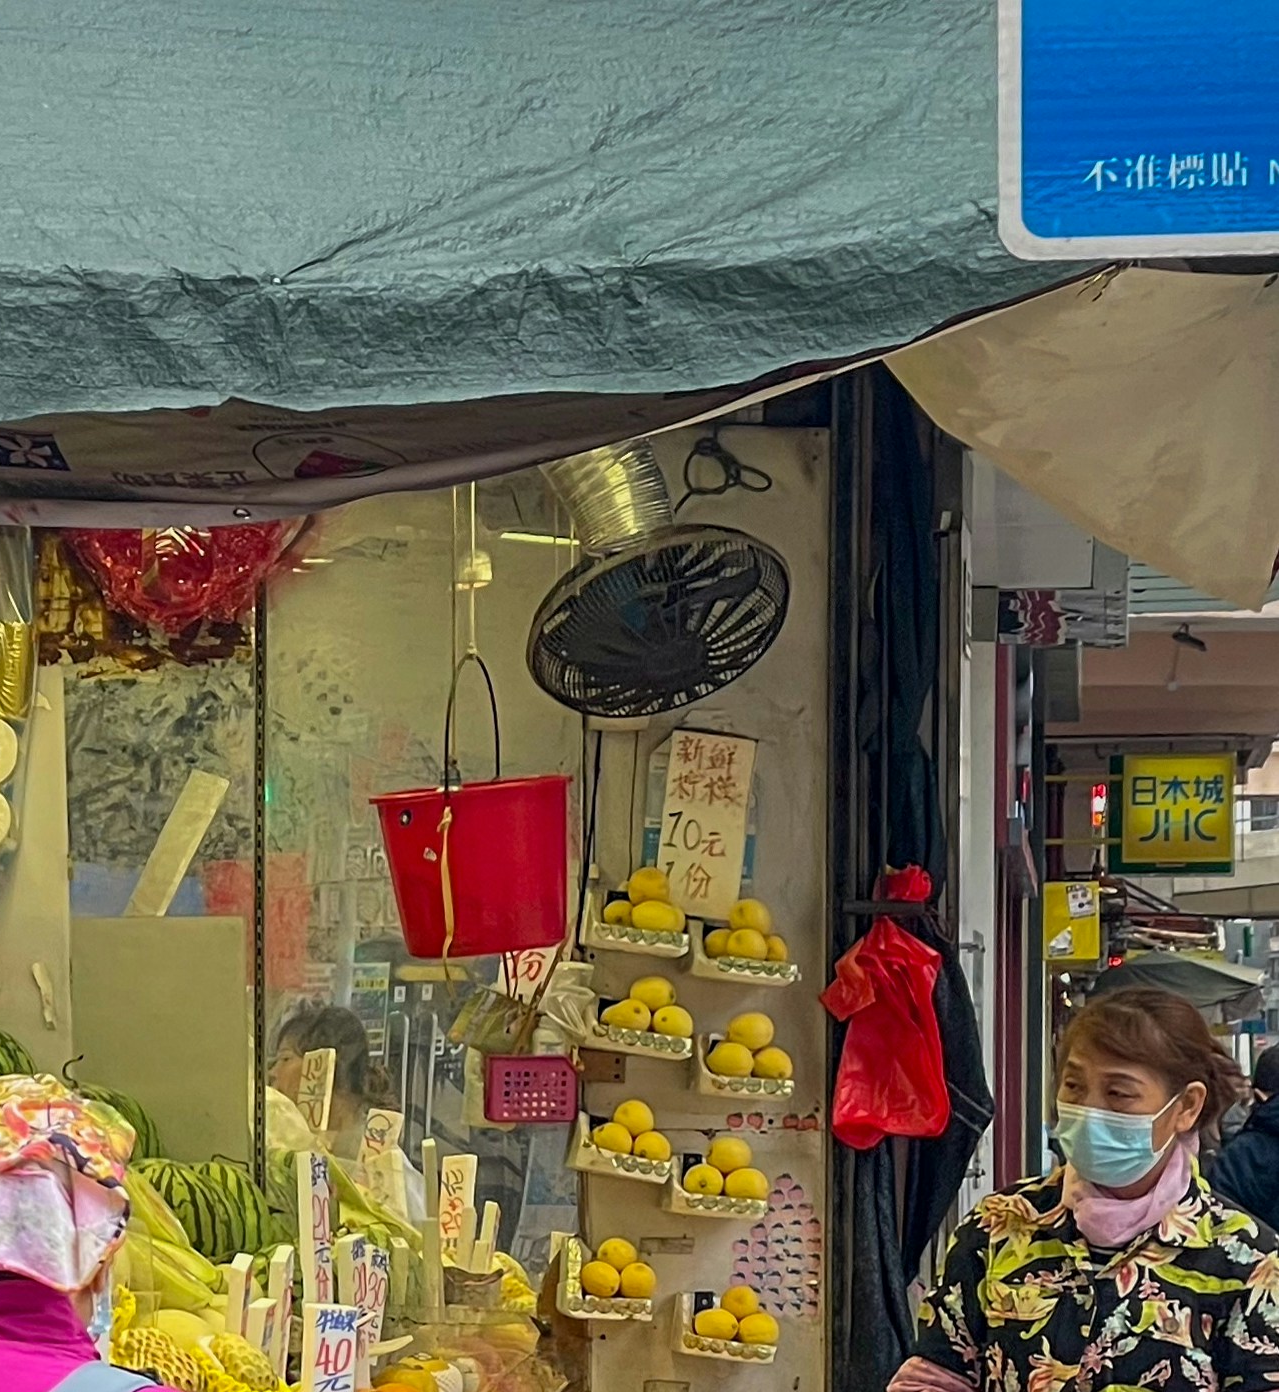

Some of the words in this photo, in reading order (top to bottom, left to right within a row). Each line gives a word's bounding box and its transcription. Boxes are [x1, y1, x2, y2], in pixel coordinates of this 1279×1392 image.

[1081, 151, 1249, 192] 不准標貼
[1138, 808, 1217, 842] JHC
[312, 1195, 331, 1242] 20
[367, 1271, 387, 1309] 30
[315, 1337, 353, 1377] 40
[315, 1372, 352, 1392] 元
